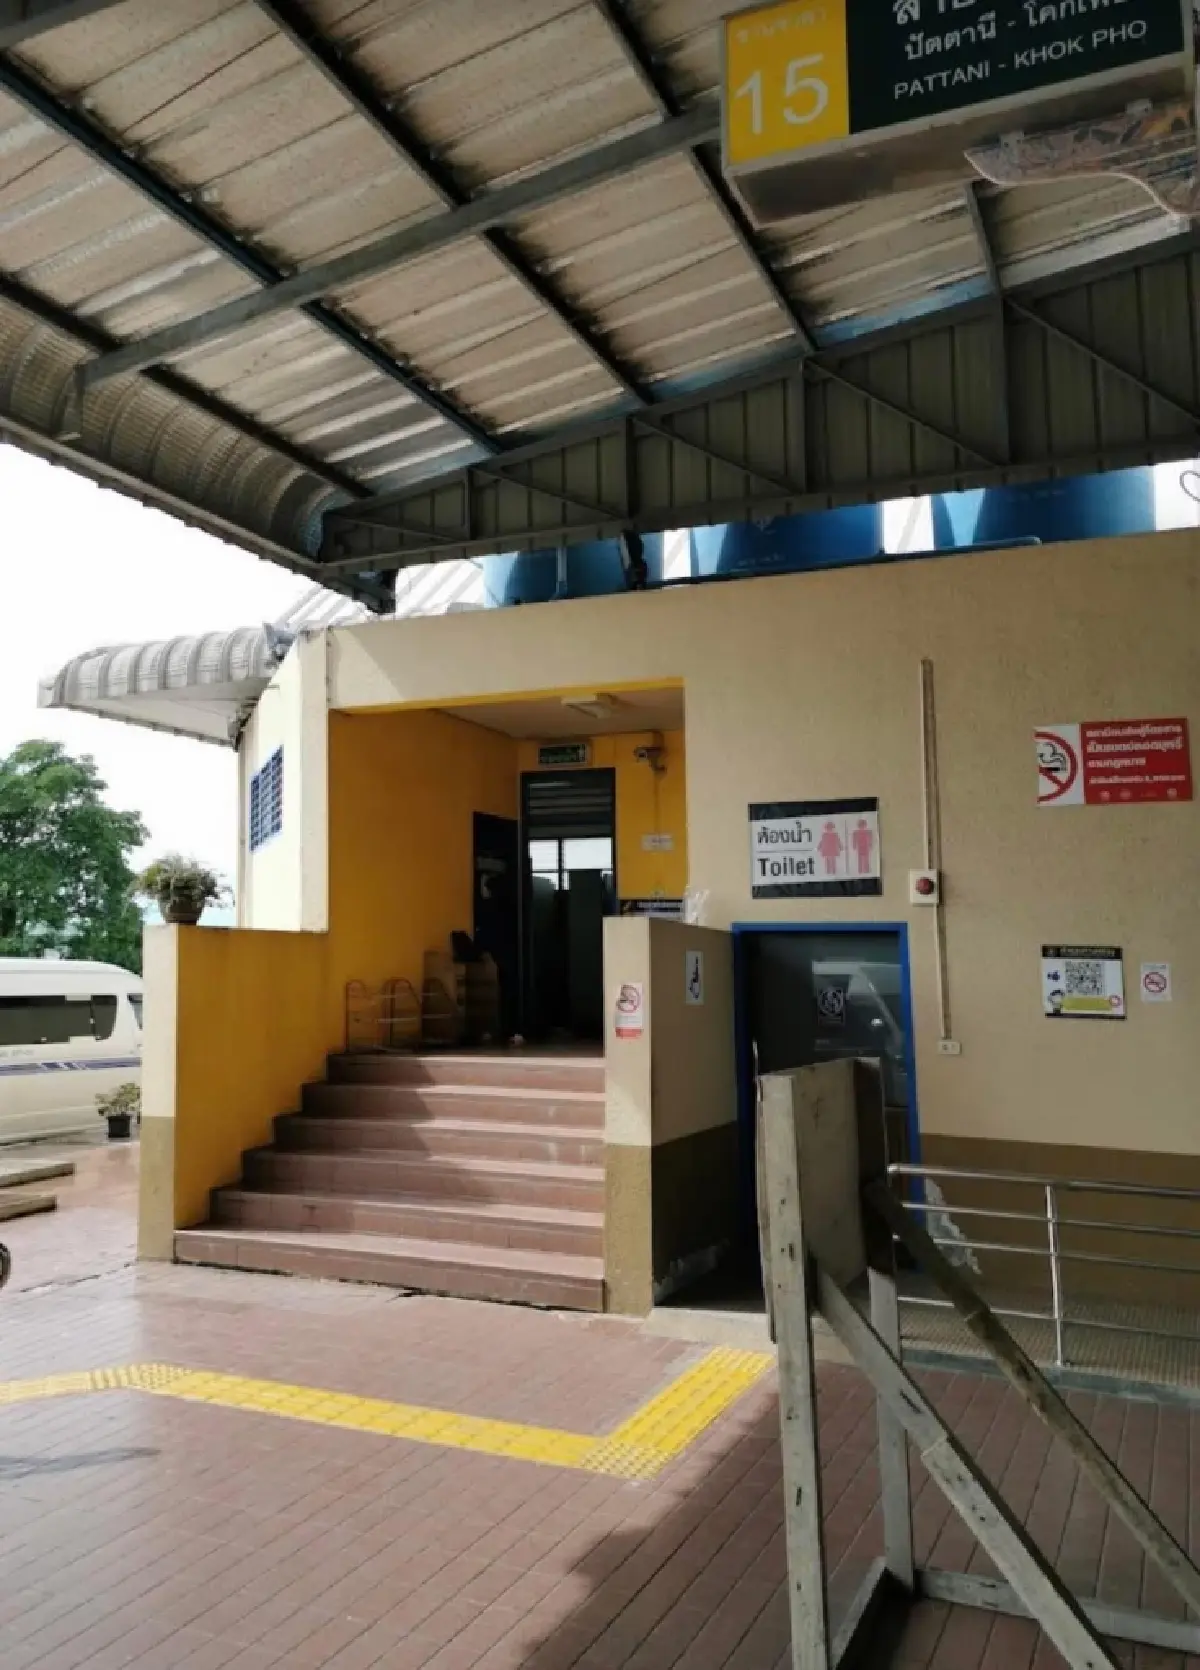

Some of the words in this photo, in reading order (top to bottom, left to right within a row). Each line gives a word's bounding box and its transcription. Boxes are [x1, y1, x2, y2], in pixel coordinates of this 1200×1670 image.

[894, 60, 991, 99] PATTANI
[1014, 36, 1084, 68] KHOK
[1092, 20, 1147, 48] PHO
[904, 10, 996, 60] ปัตตานี
[735, 53, 829, 135] 15
[757, 820, 813, 843] ห้องน้ำ
[757, 856, 815, 876] Toilet
